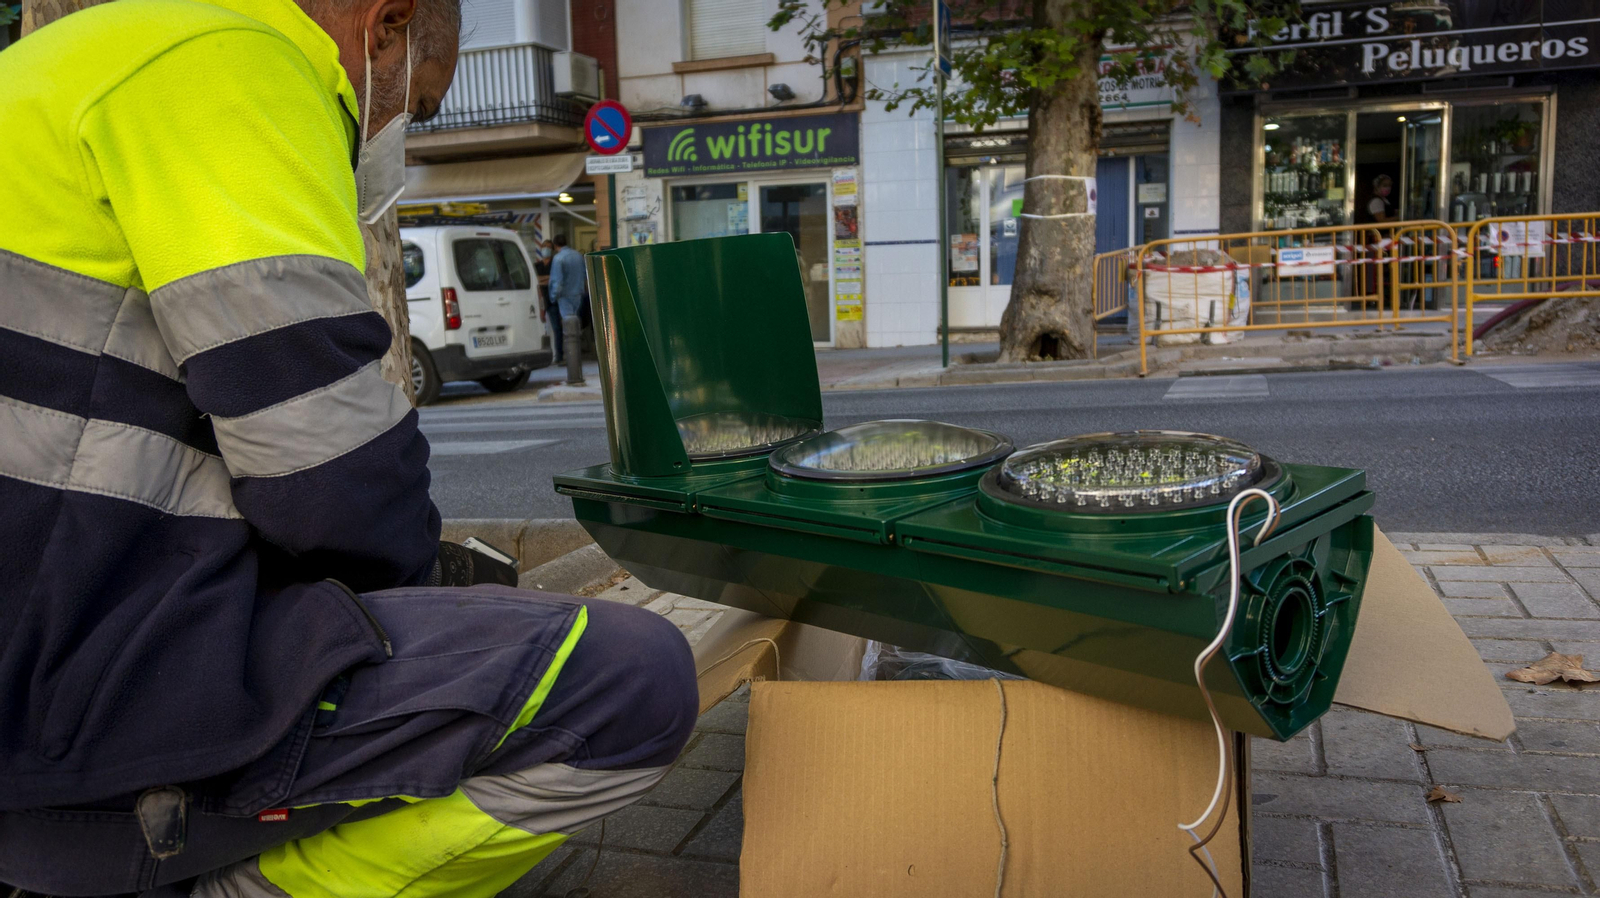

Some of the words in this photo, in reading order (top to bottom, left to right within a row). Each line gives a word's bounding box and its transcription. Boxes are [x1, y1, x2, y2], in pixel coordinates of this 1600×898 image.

[1361, 36, 1590, 73] Peluqueros
[706, 123, 831, 159] wifisur
[648, 167, 669, 175] Redes
[671, 165, 686, 173] Wifi
[692, 162, 735, 172] Informática
[795, 156, 855, 165] Videovigilancia
